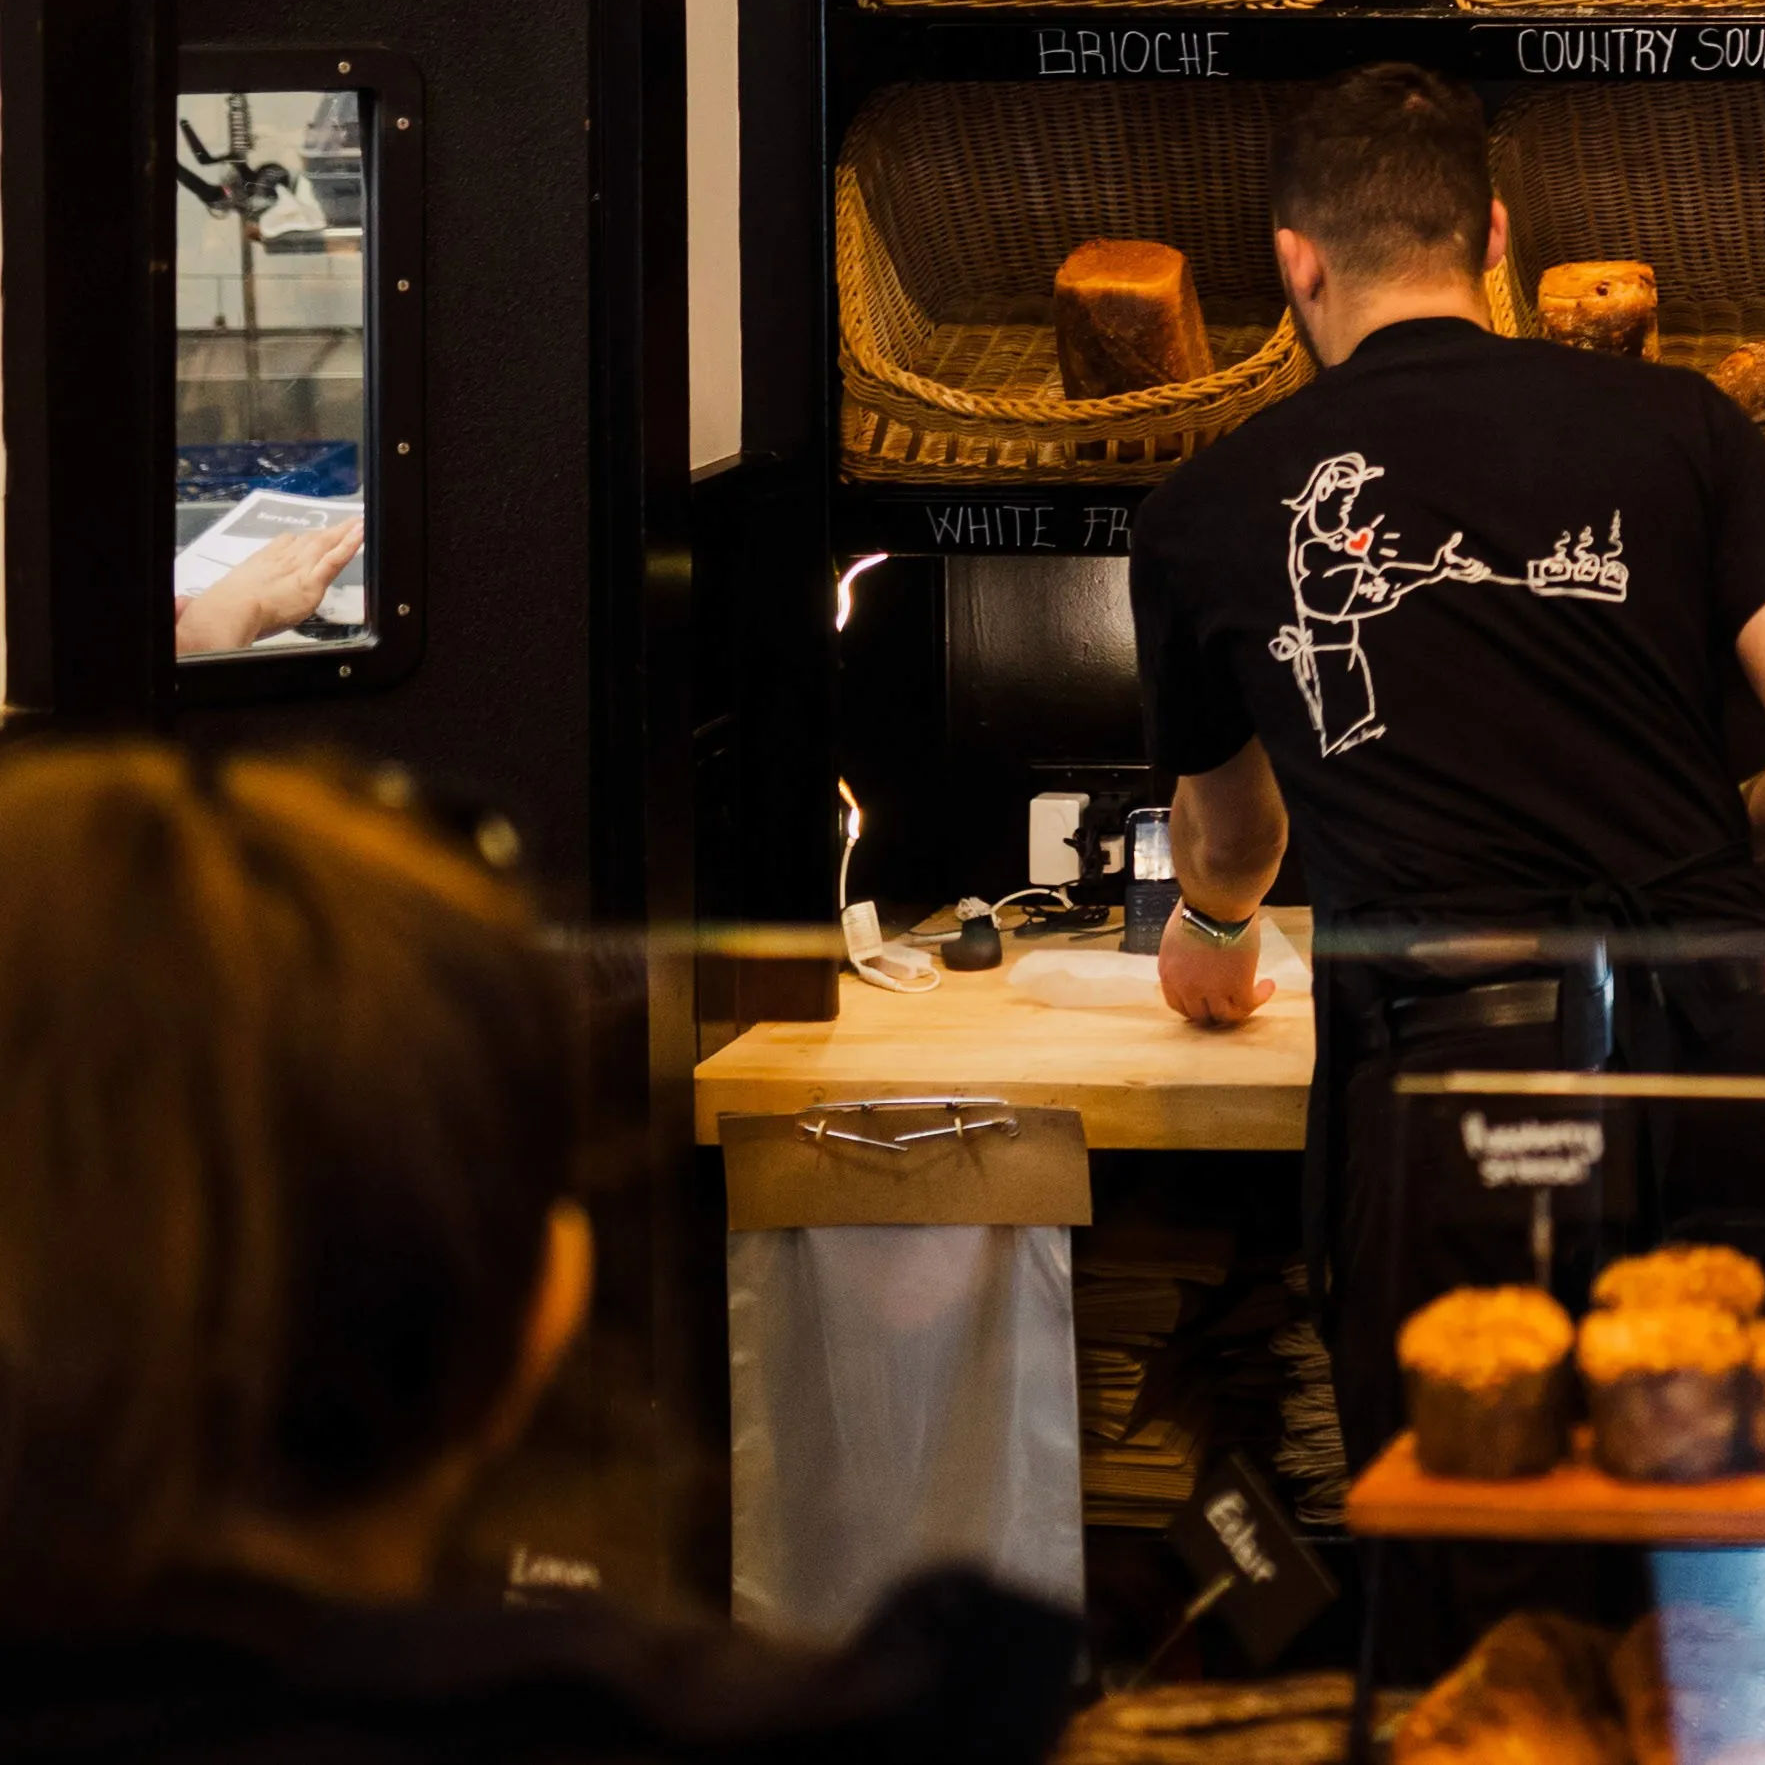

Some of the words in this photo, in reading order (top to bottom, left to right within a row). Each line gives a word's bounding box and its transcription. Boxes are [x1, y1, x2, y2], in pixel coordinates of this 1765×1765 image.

[1038, 30, 1230, 76] BRIOCHE
[1519, 29, 1676, 75] COUNTRY
[926, 505, 1056, 548] WHITE
